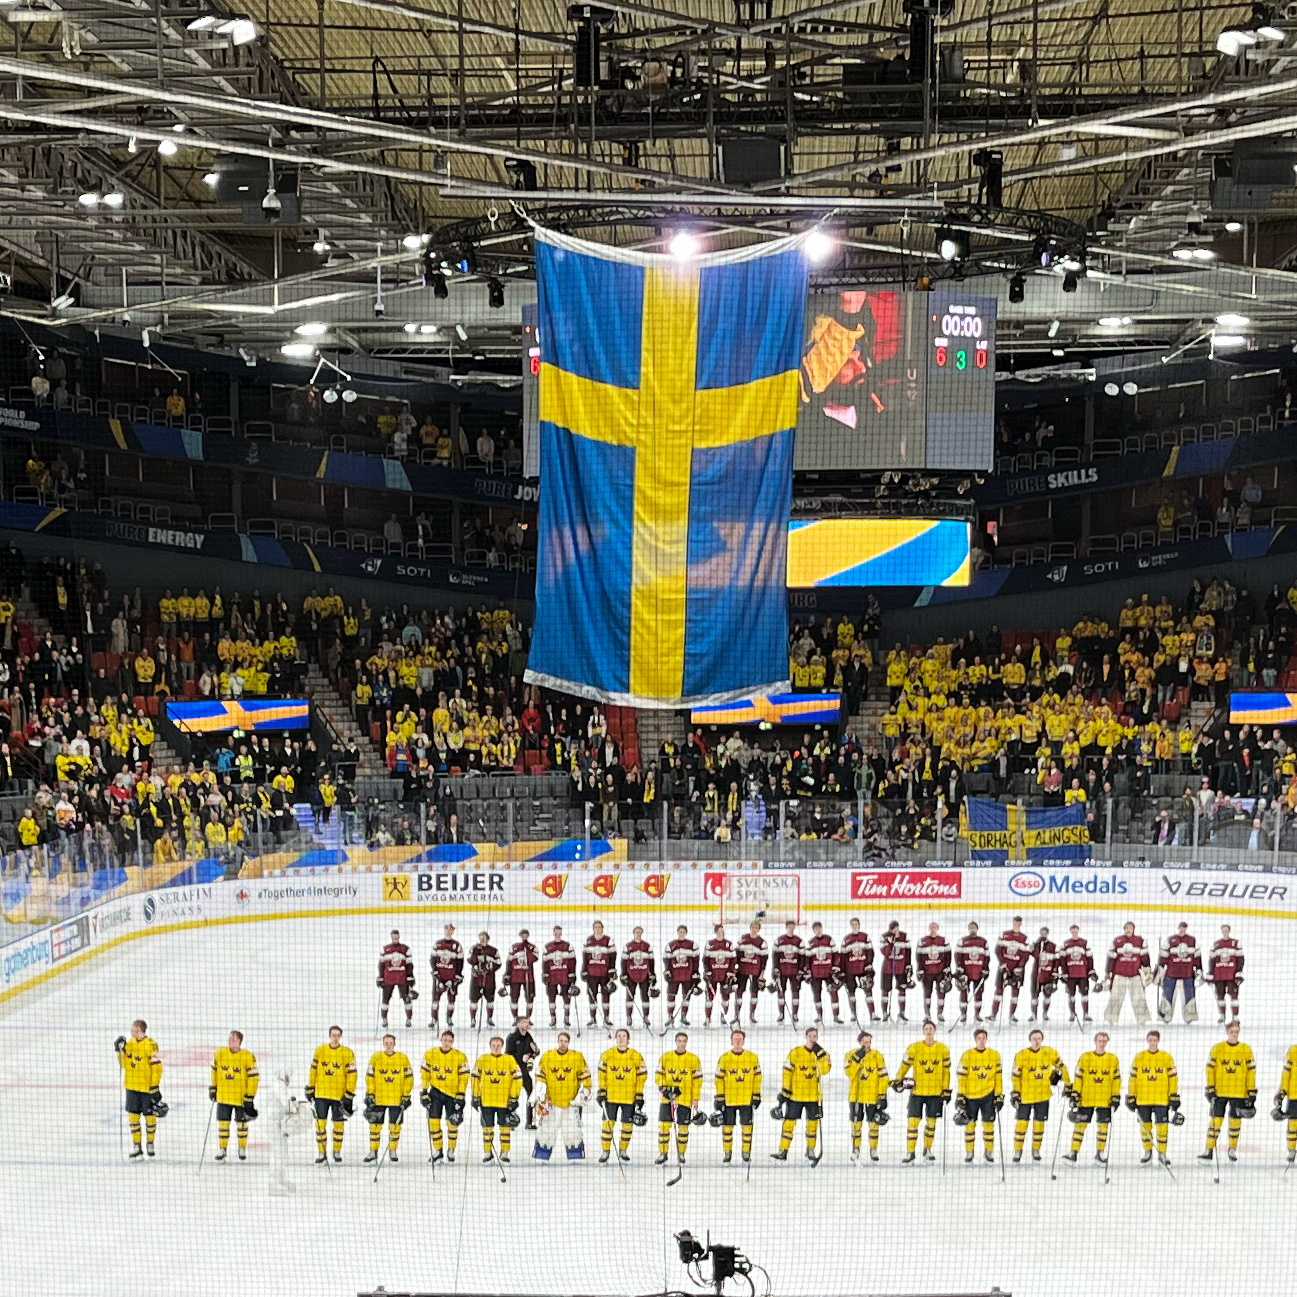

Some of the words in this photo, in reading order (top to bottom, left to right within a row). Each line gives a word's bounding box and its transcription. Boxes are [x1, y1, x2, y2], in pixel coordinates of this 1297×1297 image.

[942, 315, 982, 338] 00:00
[956, 350, 967, 370] 3
[976, 349, 987, 368] 0
[1047, 466, 1098, 489] SKILLS
[514, 484, 539, 502] JOY
[148, 527, 205, 549] ENERGY
[396, 565, 431, 578] SOTI
[1083, 561, 1119, 575] SOTI
[417, 873, 504, 891] BEIJER
[855, 875, 887, 897] Tim
[890, 873, 959, 898] Hortons
[1013, 877, 1041, 890] Esso
[1048, 874, 1128, 894] Medals
[159, 887, 213, 904] SERAFIM
